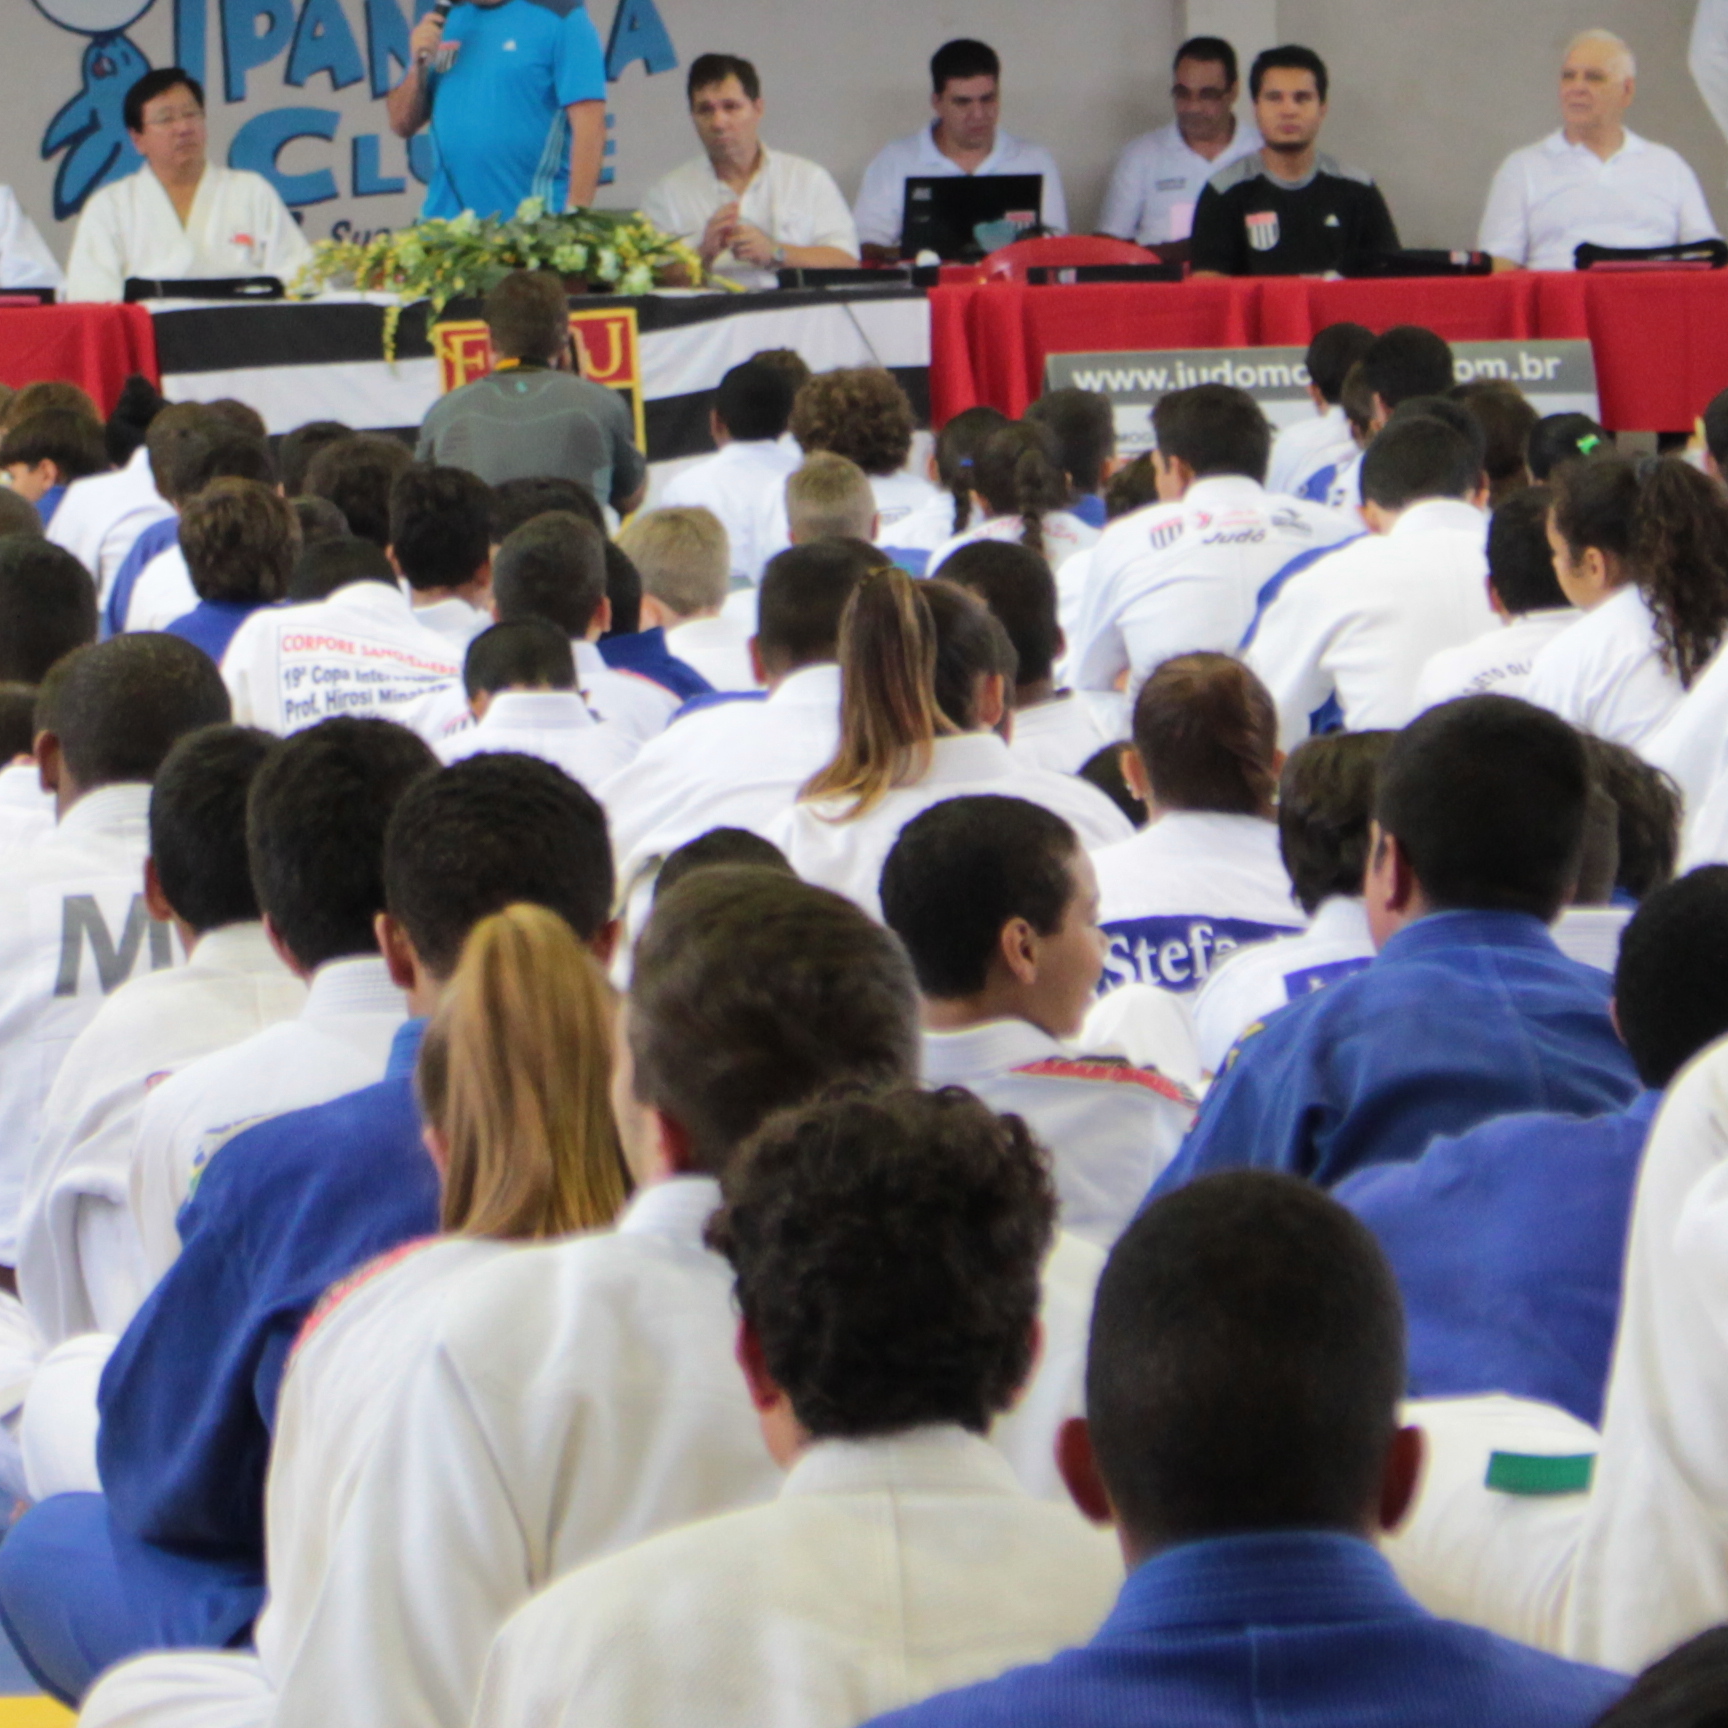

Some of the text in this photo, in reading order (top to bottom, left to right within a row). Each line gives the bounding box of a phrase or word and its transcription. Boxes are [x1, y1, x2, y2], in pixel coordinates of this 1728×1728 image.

[282, 634, 356, 654] CORPORE
[312, 665, 351, 686] Copa
[325, 689, 374, 713] Hirosi
[1104, 923, 1238, 986] Stef
